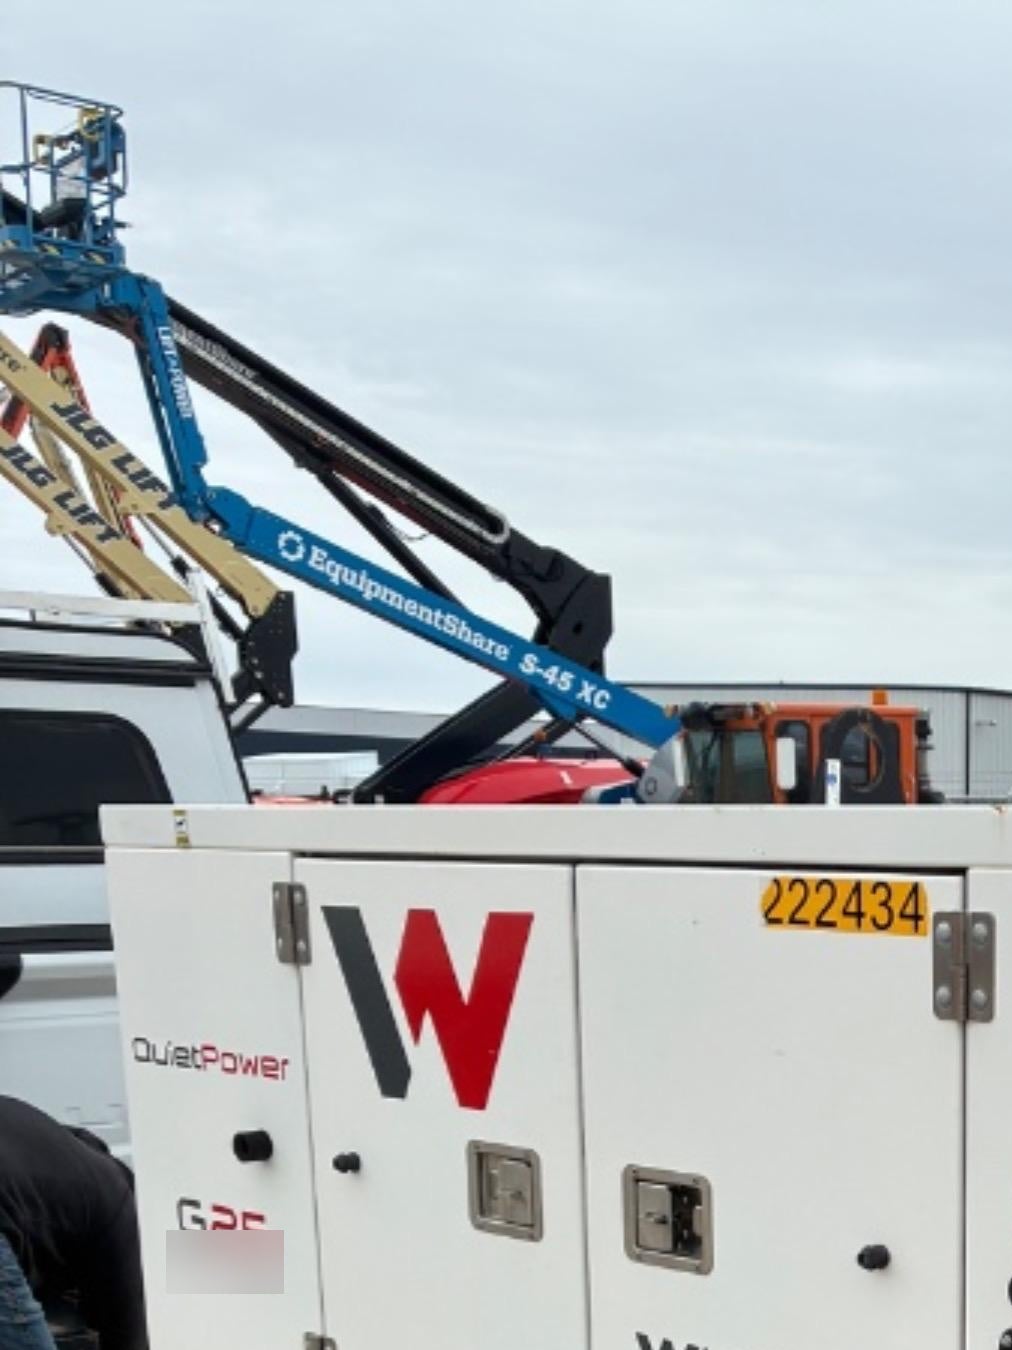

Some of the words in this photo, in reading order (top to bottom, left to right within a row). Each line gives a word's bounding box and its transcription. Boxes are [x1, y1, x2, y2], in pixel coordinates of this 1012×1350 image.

[0, 444, 57, 487] JLG
[54, 490, 121, 543] LIFT
[50, 402, 116, 450] JLG
[111, 452, 180, 510] LIFT
[307, 544, 510, 662] EquipmentShare
[518, 652, 575, 692] S-45
[575, 679, 612, 710] XC
[764, 877, 924, 933] 222434
[132, 1036, 290, 1081] QuietPower
